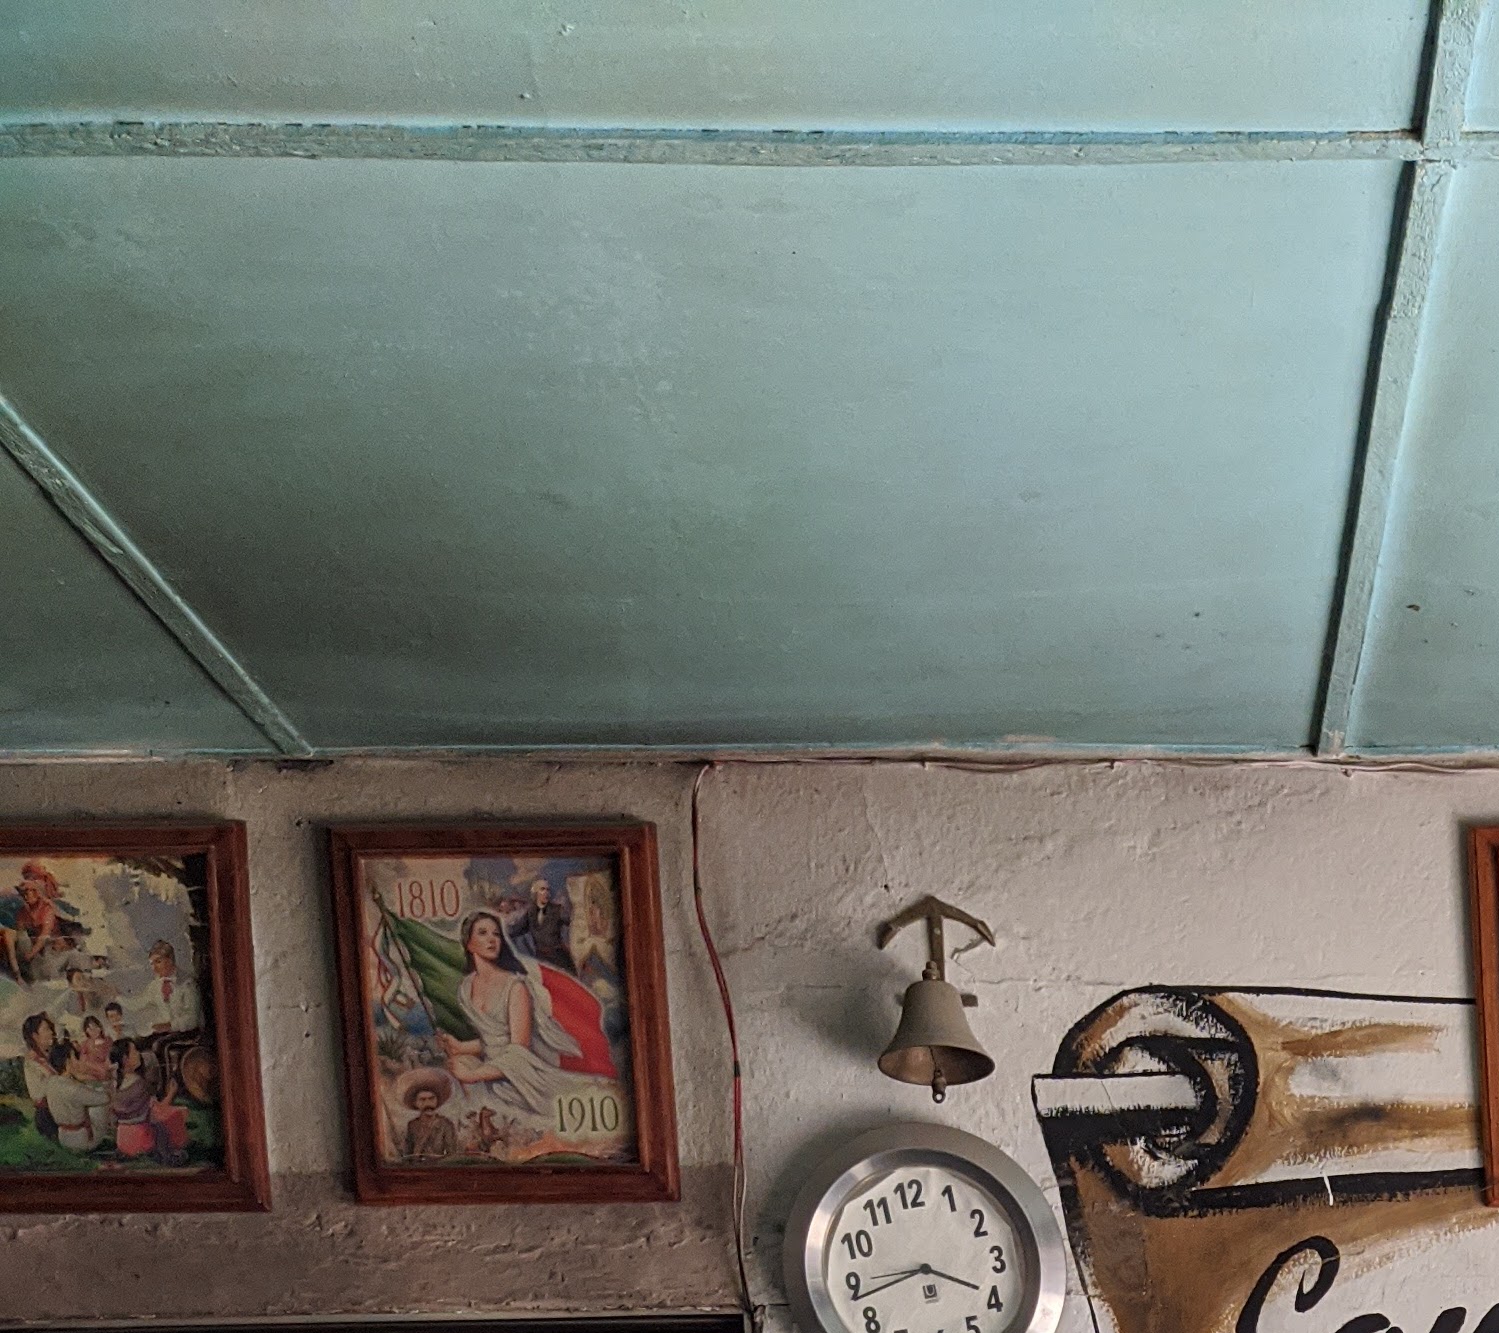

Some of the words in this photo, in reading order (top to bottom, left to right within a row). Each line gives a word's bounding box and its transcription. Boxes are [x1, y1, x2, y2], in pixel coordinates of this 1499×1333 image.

[397, 880, 460, 918] 1810
[558, 1096, 620, 1133] 1910
[893, 1179, 925, 1210] 12
[941, 1185, 957, 1212] 1
[863, 1196, 892, 1226] 11
[970, 1209, 988, 1237] 2
[841, 1229, 873, 1259] 10
[989, 1246, 1006, 1273] 3
[845, 1272, 861, 1300] 9
[986, 1285, 1003, 1312] 4
